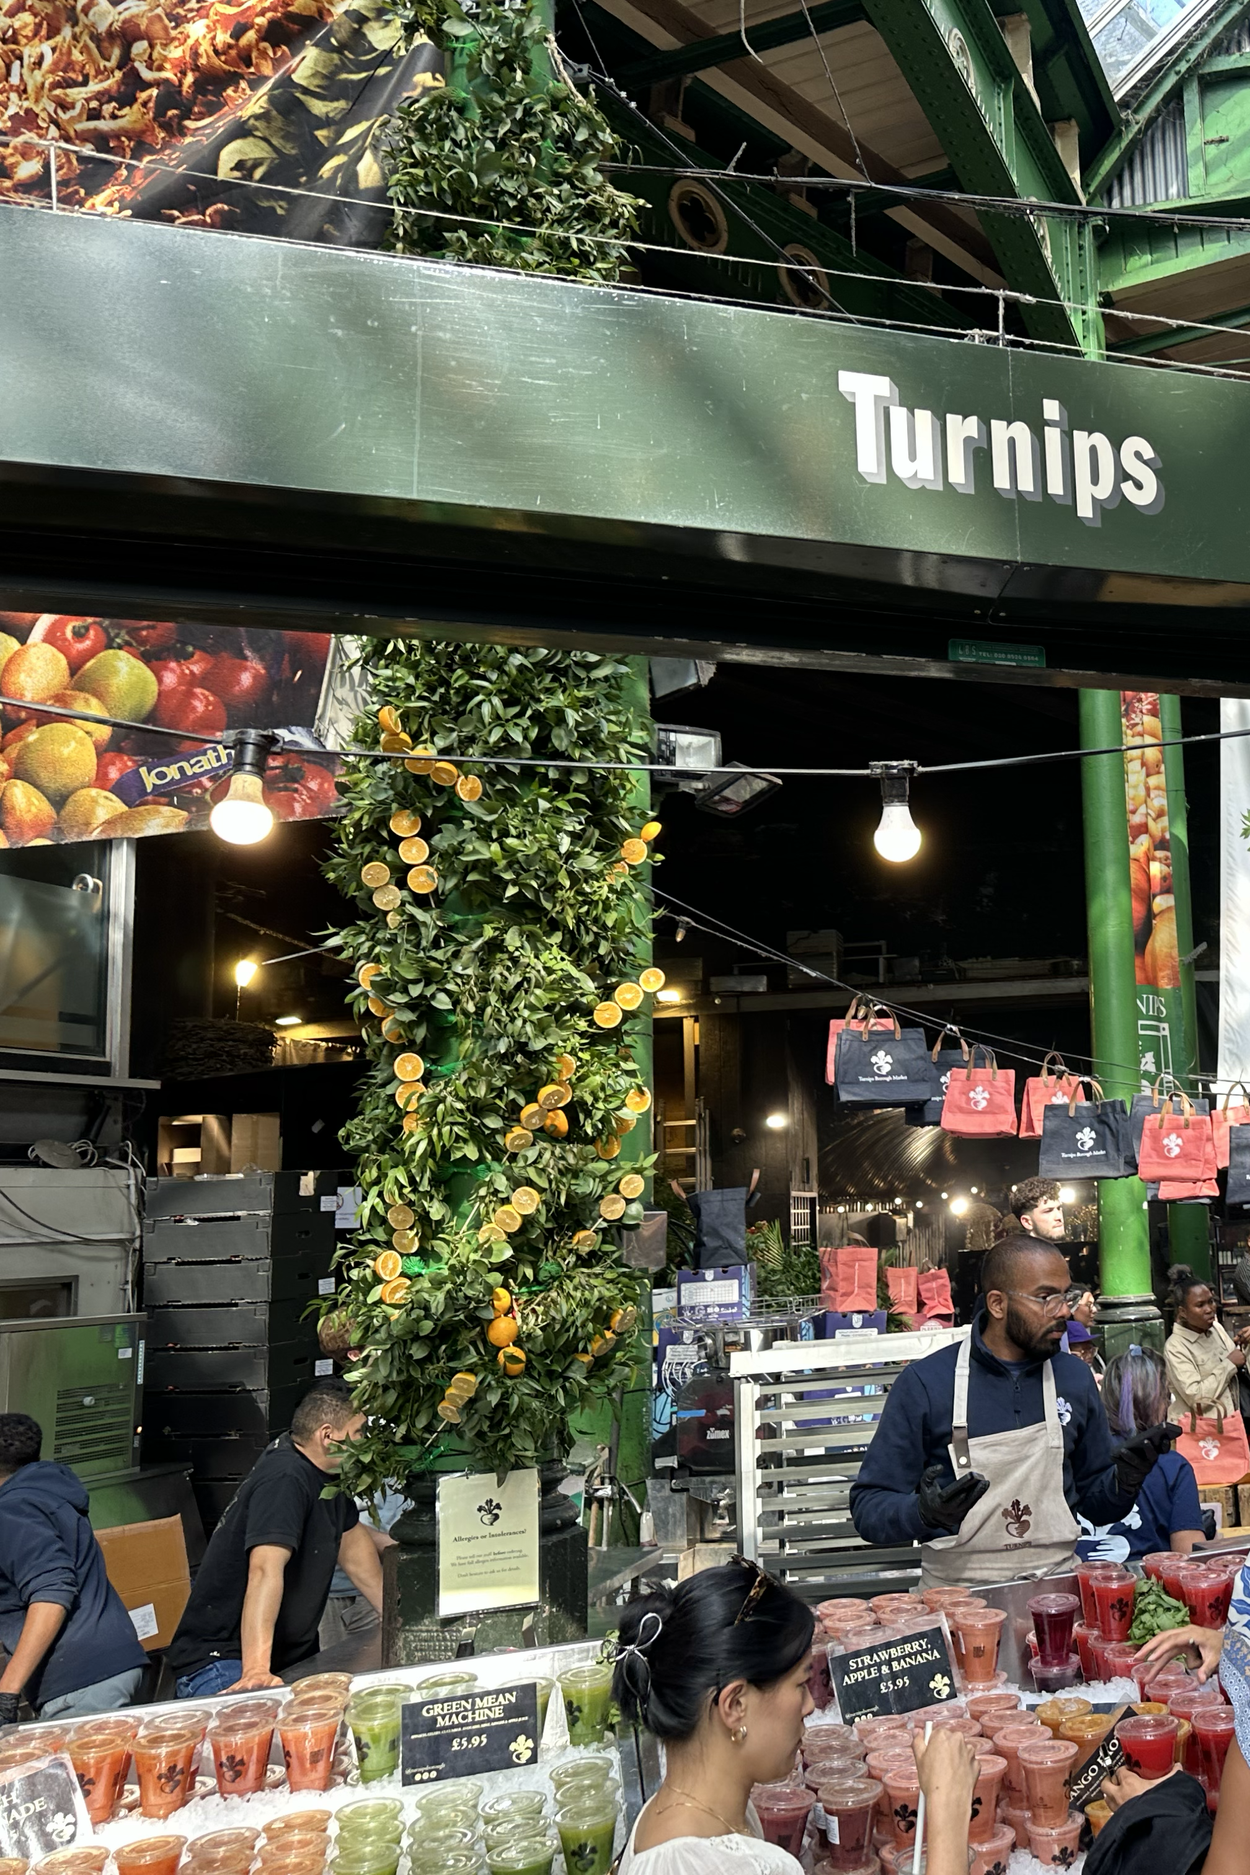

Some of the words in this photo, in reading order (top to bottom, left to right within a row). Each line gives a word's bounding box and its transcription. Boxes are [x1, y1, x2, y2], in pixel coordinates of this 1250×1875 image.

[838, 370, 1165, 526] Turnips
[139, 744, 235, 793] Jonath
[1136, 994, 1167, 1018] NIPS
[453, 1534, 479, 1543] Allergies
[488, 1529, 527, 1539] Intolerances?
[849, 1638, 931, 1670] STRAWBERRY,
[842, 1666, 879, 1686] APPLE
[881, 1664, 890, 1674] &
[891, 1649, 941, 1673] BANANA
[880, 1675, 910, 1694] £5.95
[421, 1699, 472, 1717] GREEN
[474, 1691, 517, 1709] MEAN
[436, 1706, 504, 1727] MACHINE
[451, 1733, 488, 1751] £5.95
[1069, 1764, 1099, 1802] ANGO
